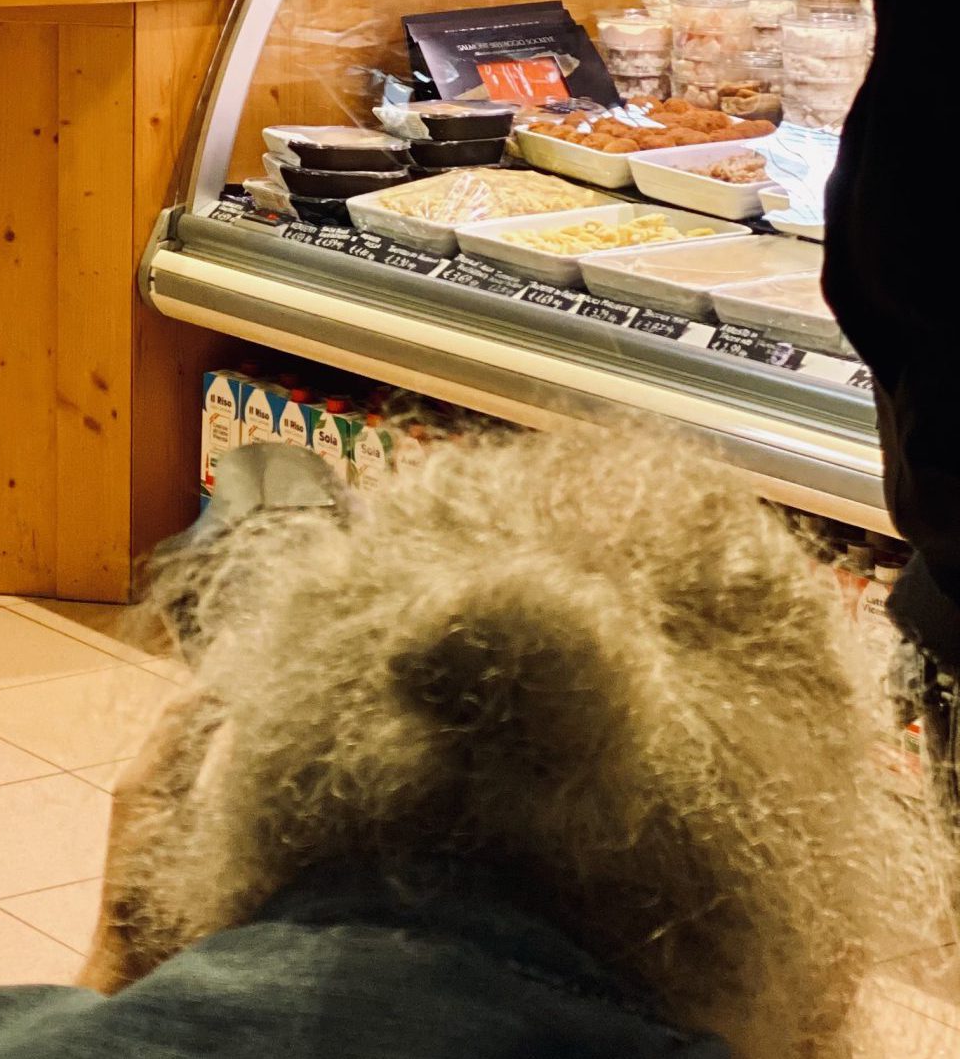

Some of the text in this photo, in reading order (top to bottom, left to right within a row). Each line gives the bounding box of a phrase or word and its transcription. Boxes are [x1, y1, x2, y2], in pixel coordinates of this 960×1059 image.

[217, 395, 233, 408] Riso
[255, 407, 270, 420] Riso
[289, 420, 304, 433] Riso
[318, 430, 338, 447] Soia
[360, 443, 381, 459] Soia
